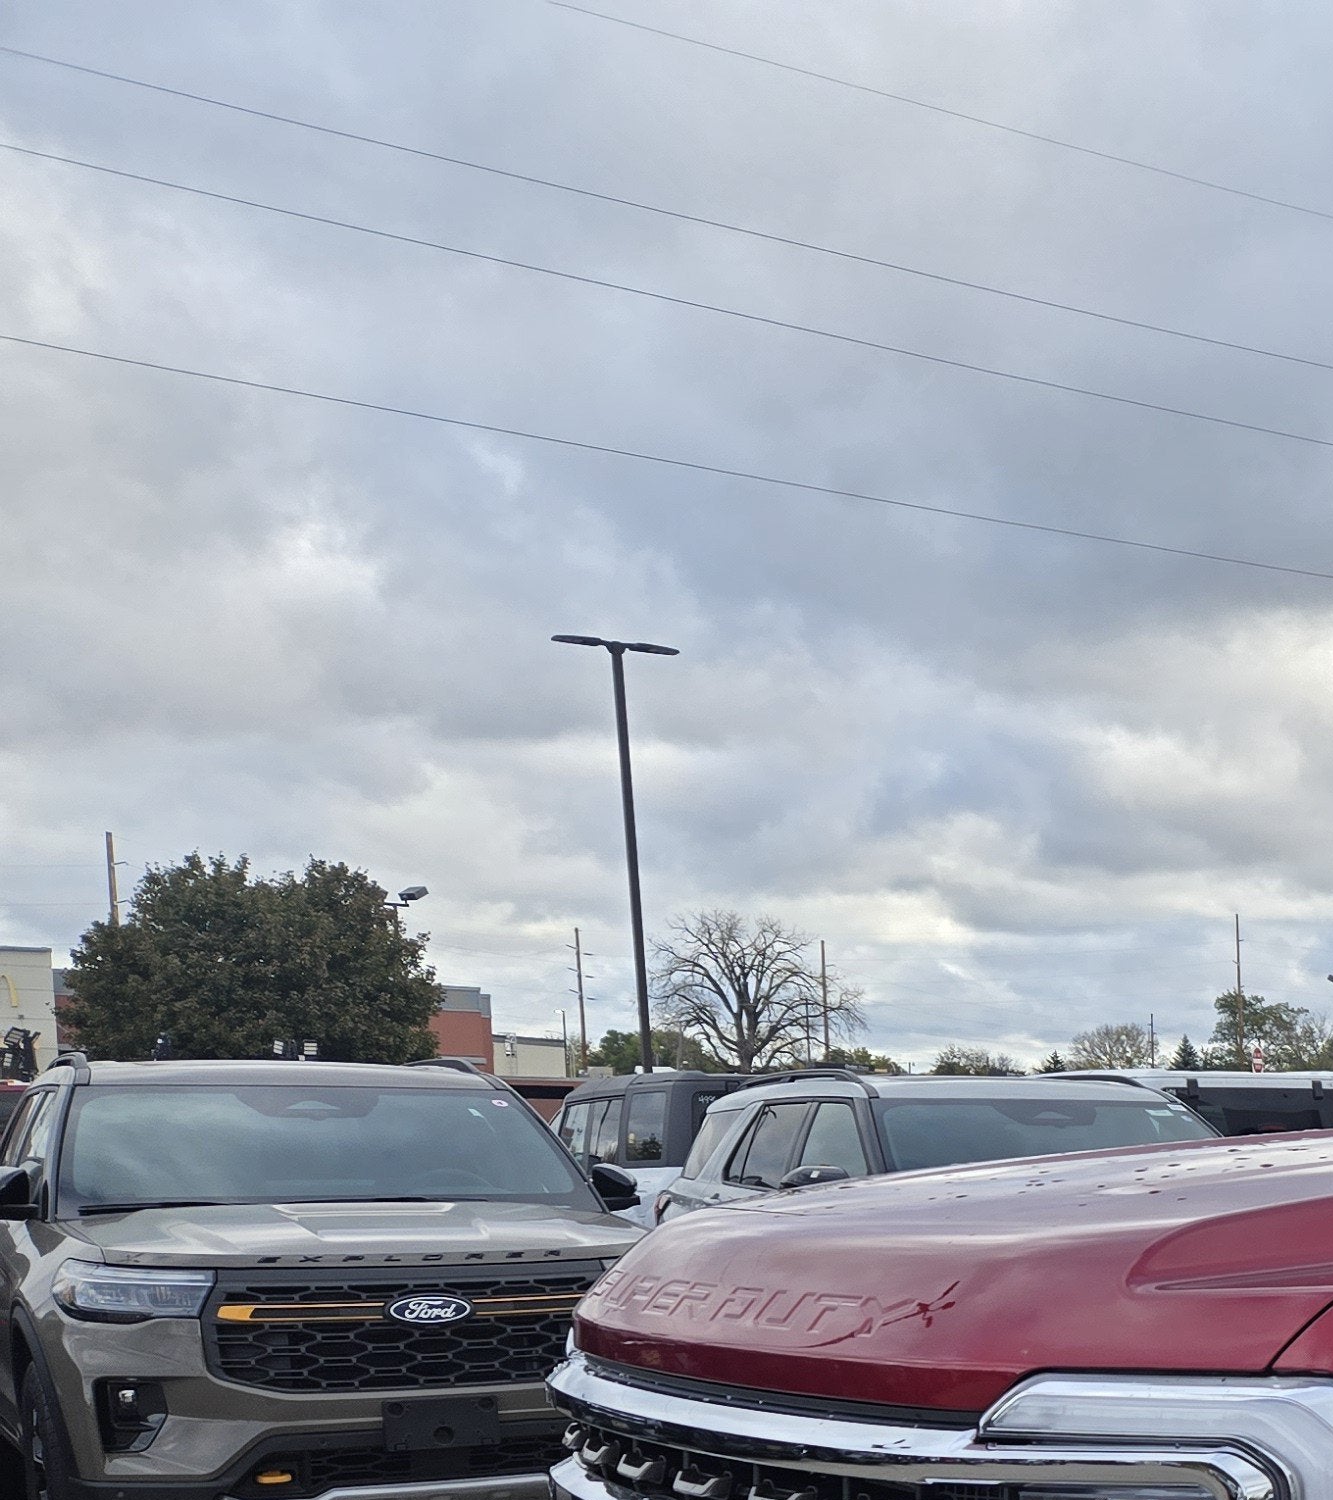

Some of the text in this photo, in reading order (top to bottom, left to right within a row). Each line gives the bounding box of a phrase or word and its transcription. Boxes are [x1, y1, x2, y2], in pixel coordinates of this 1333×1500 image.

[257, 1249, 561, 1264] EXPLORER
[404, 1299, 457, 1318] Ford
[588, 1270, 914, 1337] SUPER DUTY
